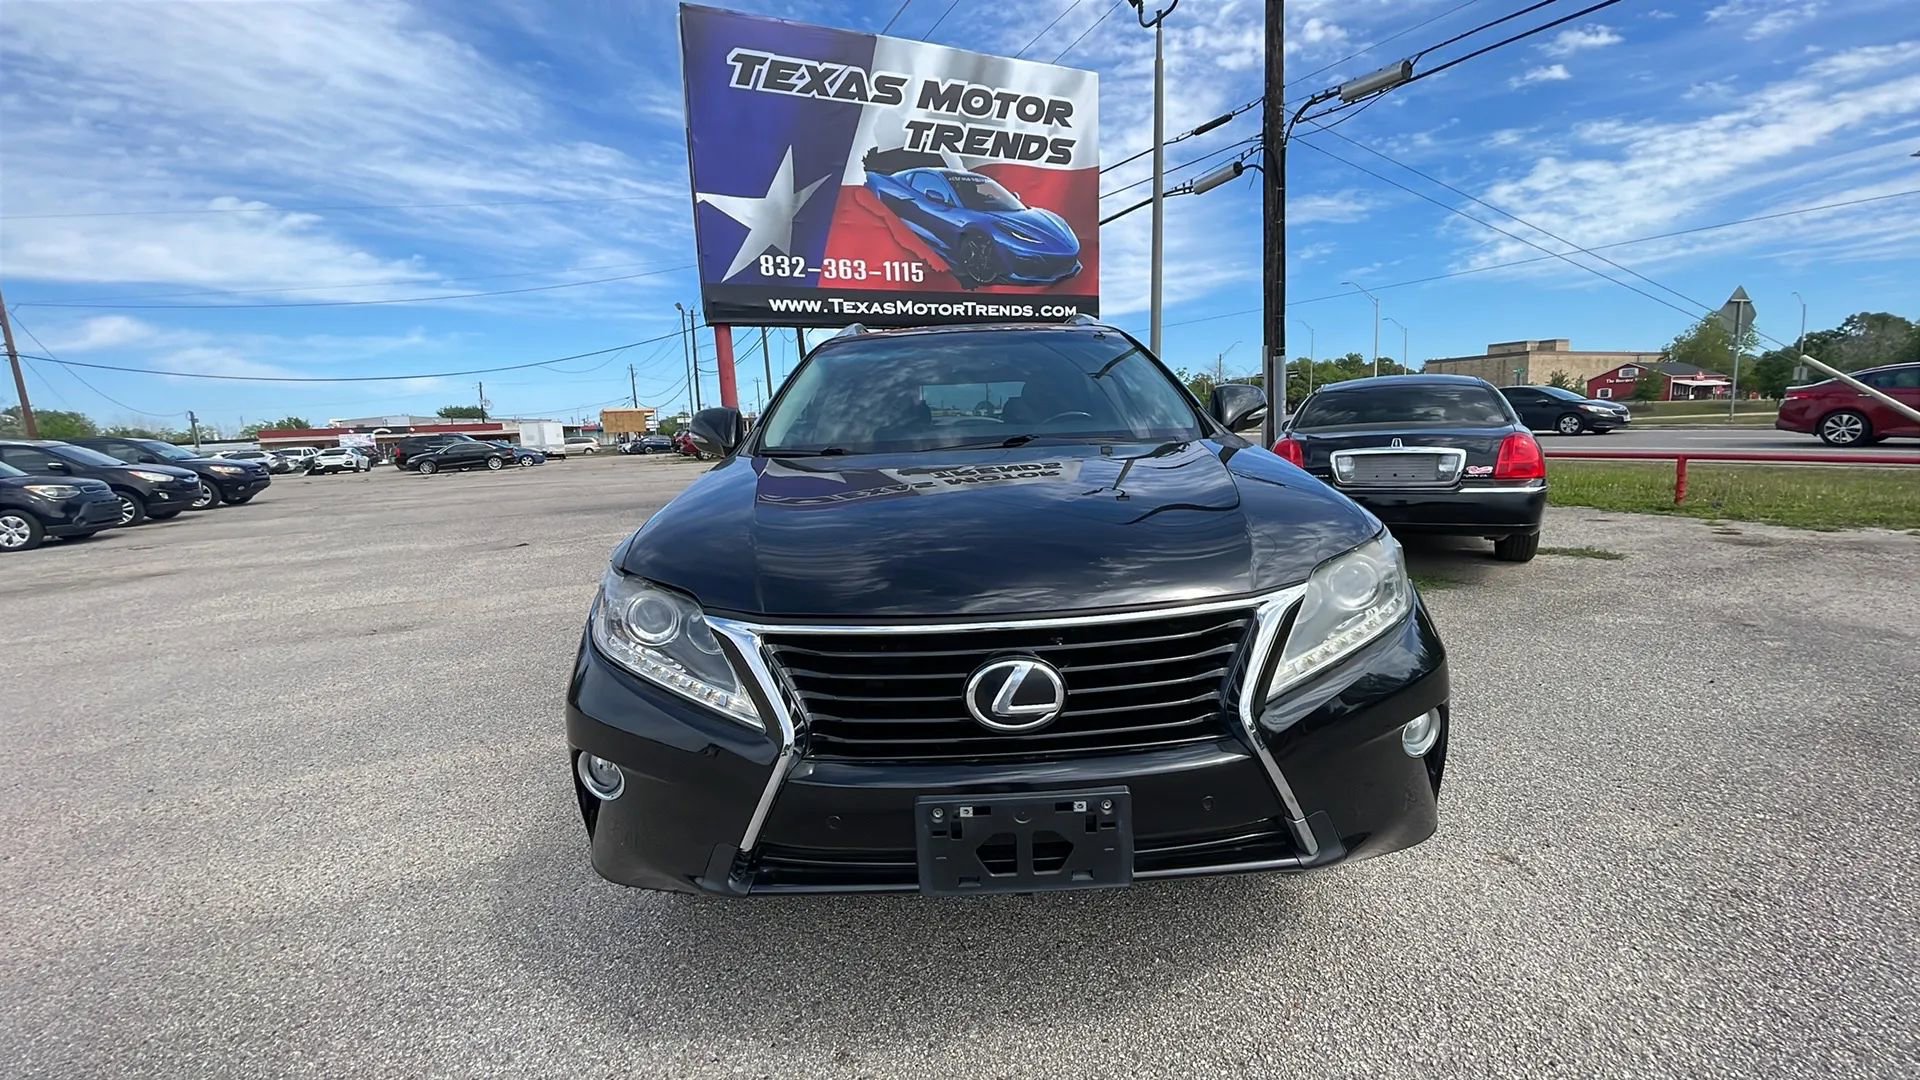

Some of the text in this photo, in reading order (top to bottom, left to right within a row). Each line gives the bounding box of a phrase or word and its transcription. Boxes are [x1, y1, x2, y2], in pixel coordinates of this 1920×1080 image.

[728, 49, 1075, 129] TEXAS MOTOR
[904, 118, 1077, 166] TRENDS
[759, 254, 924, 283] 832-363-1115
